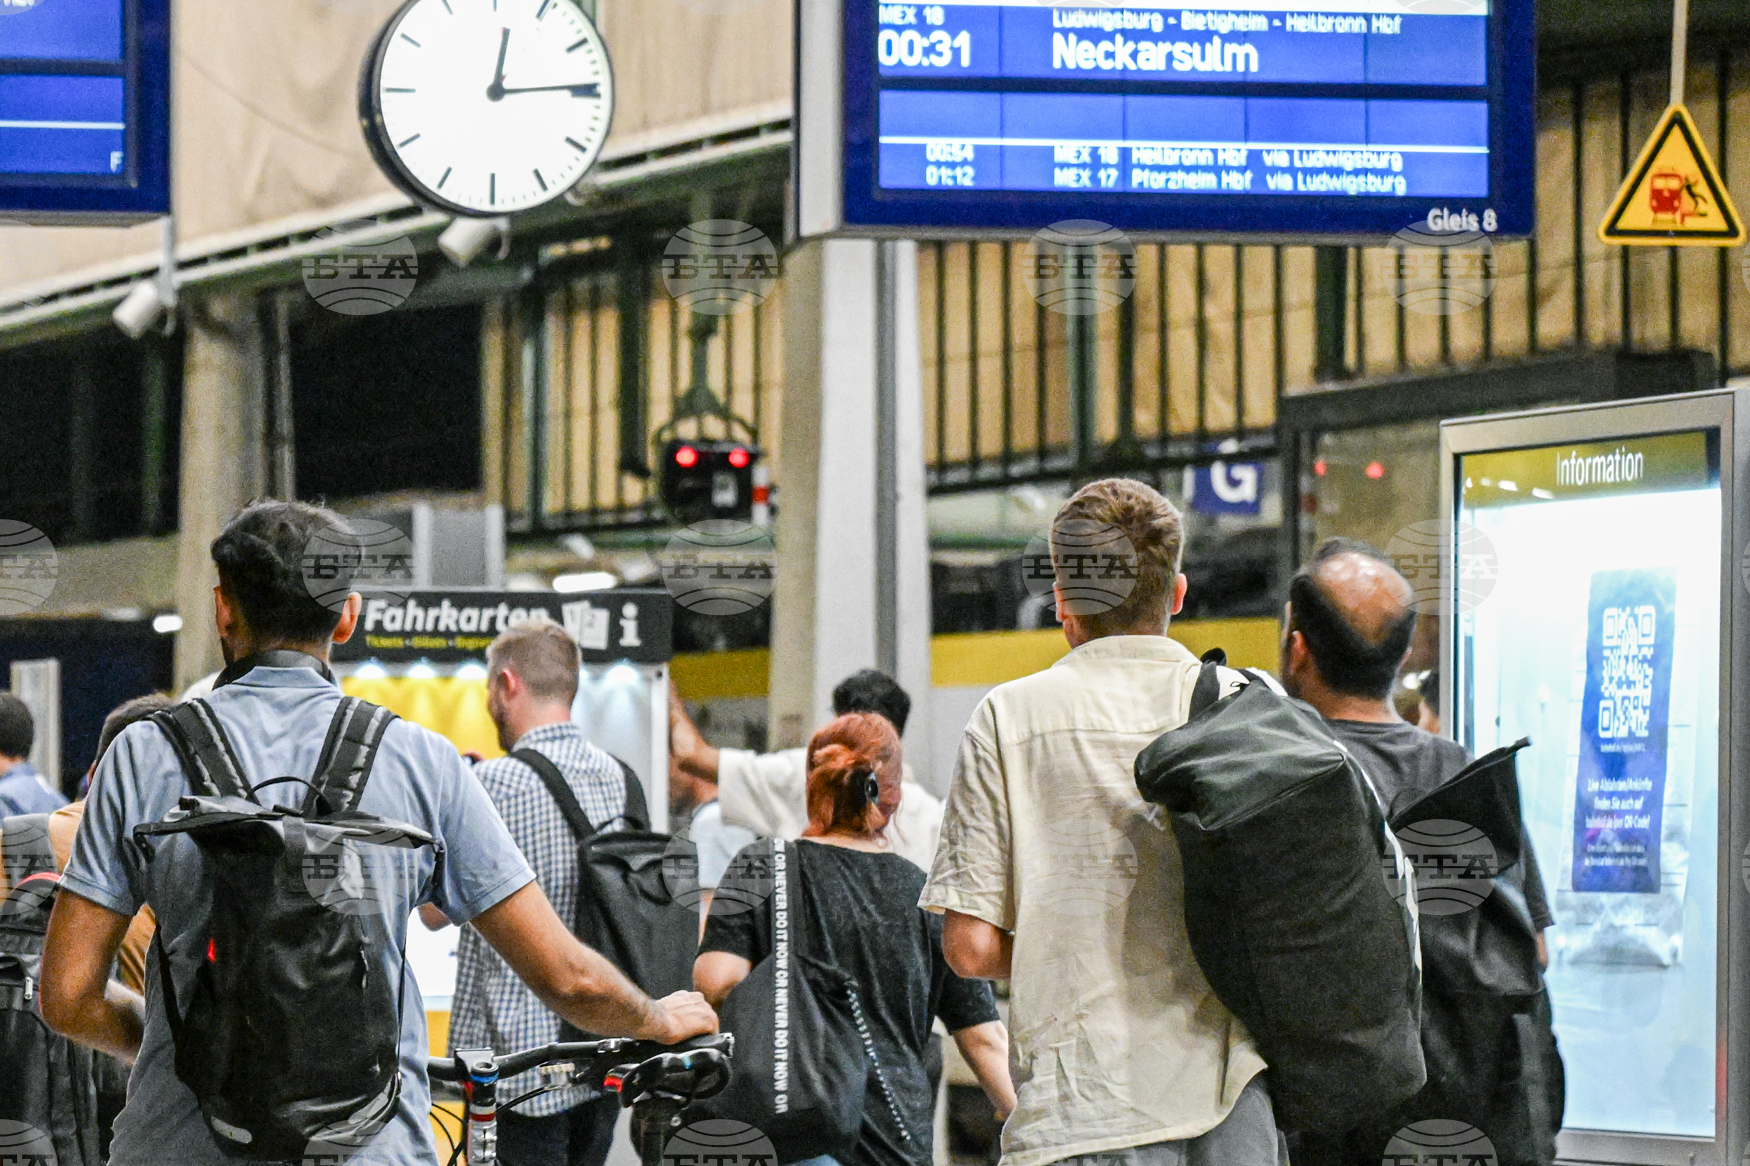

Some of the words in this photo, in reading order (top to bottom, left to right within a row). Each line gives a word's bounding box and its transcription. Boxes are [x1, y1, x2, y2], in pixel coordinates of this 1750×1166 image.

[879, 6, 917, 24] MEX
[1053, 9, 1163, 31] Ludwigsburg
[1181, 11, 1269, 33] Bietigheim
[1286, 13, 1367, 33] Heilbronn
[1372, 14, 1403, 34] Hbf
[878, 29, 971, 68] 00:31
[1052, 33, 1259, 73] Neckarsulm
[110, 151, 124, 172] F
[1054, 145, 1092, 164] MEX
[1131, 146, 1214, 166] Heilbronn
[1218, 148, 1248, 166] Hbf
[1263, 150, 1290, 167] via
[1293, 150, 1404, 172] Ludwigsburg
[926, 166, 975, 186] 01:12
[1054, 168, 1092, 187] MEX
[1097, 168, 1119, 188] 17
[1132, 169, 1217, 189] Pforzheim
[1221, 170, 1252, 189] Hbf
[1266, 172, 1294, 191] via
[1298, 171, 1407, 196] Ludwigsburg
[1427, 208, 1480, 232] Gleis
[1482, 208, 1498, 233] 8
[1210, 438, 1258, 503] G
[1556, 445, 1644, 487] Information
[774, 853, 786, 870] OR
[775, 870, 787, 910] NEVER
[775, 911, 788, 928] DO
[775, 941, 789, 969] NOW
[775, 970, 788, 987] OR
[775, 988, 789, 1028] NEVER
[774, 1029, 789, 1048] DO
[774, 1062, 788, 1091] NOW
[775, 1093, 788, 1114] OR
